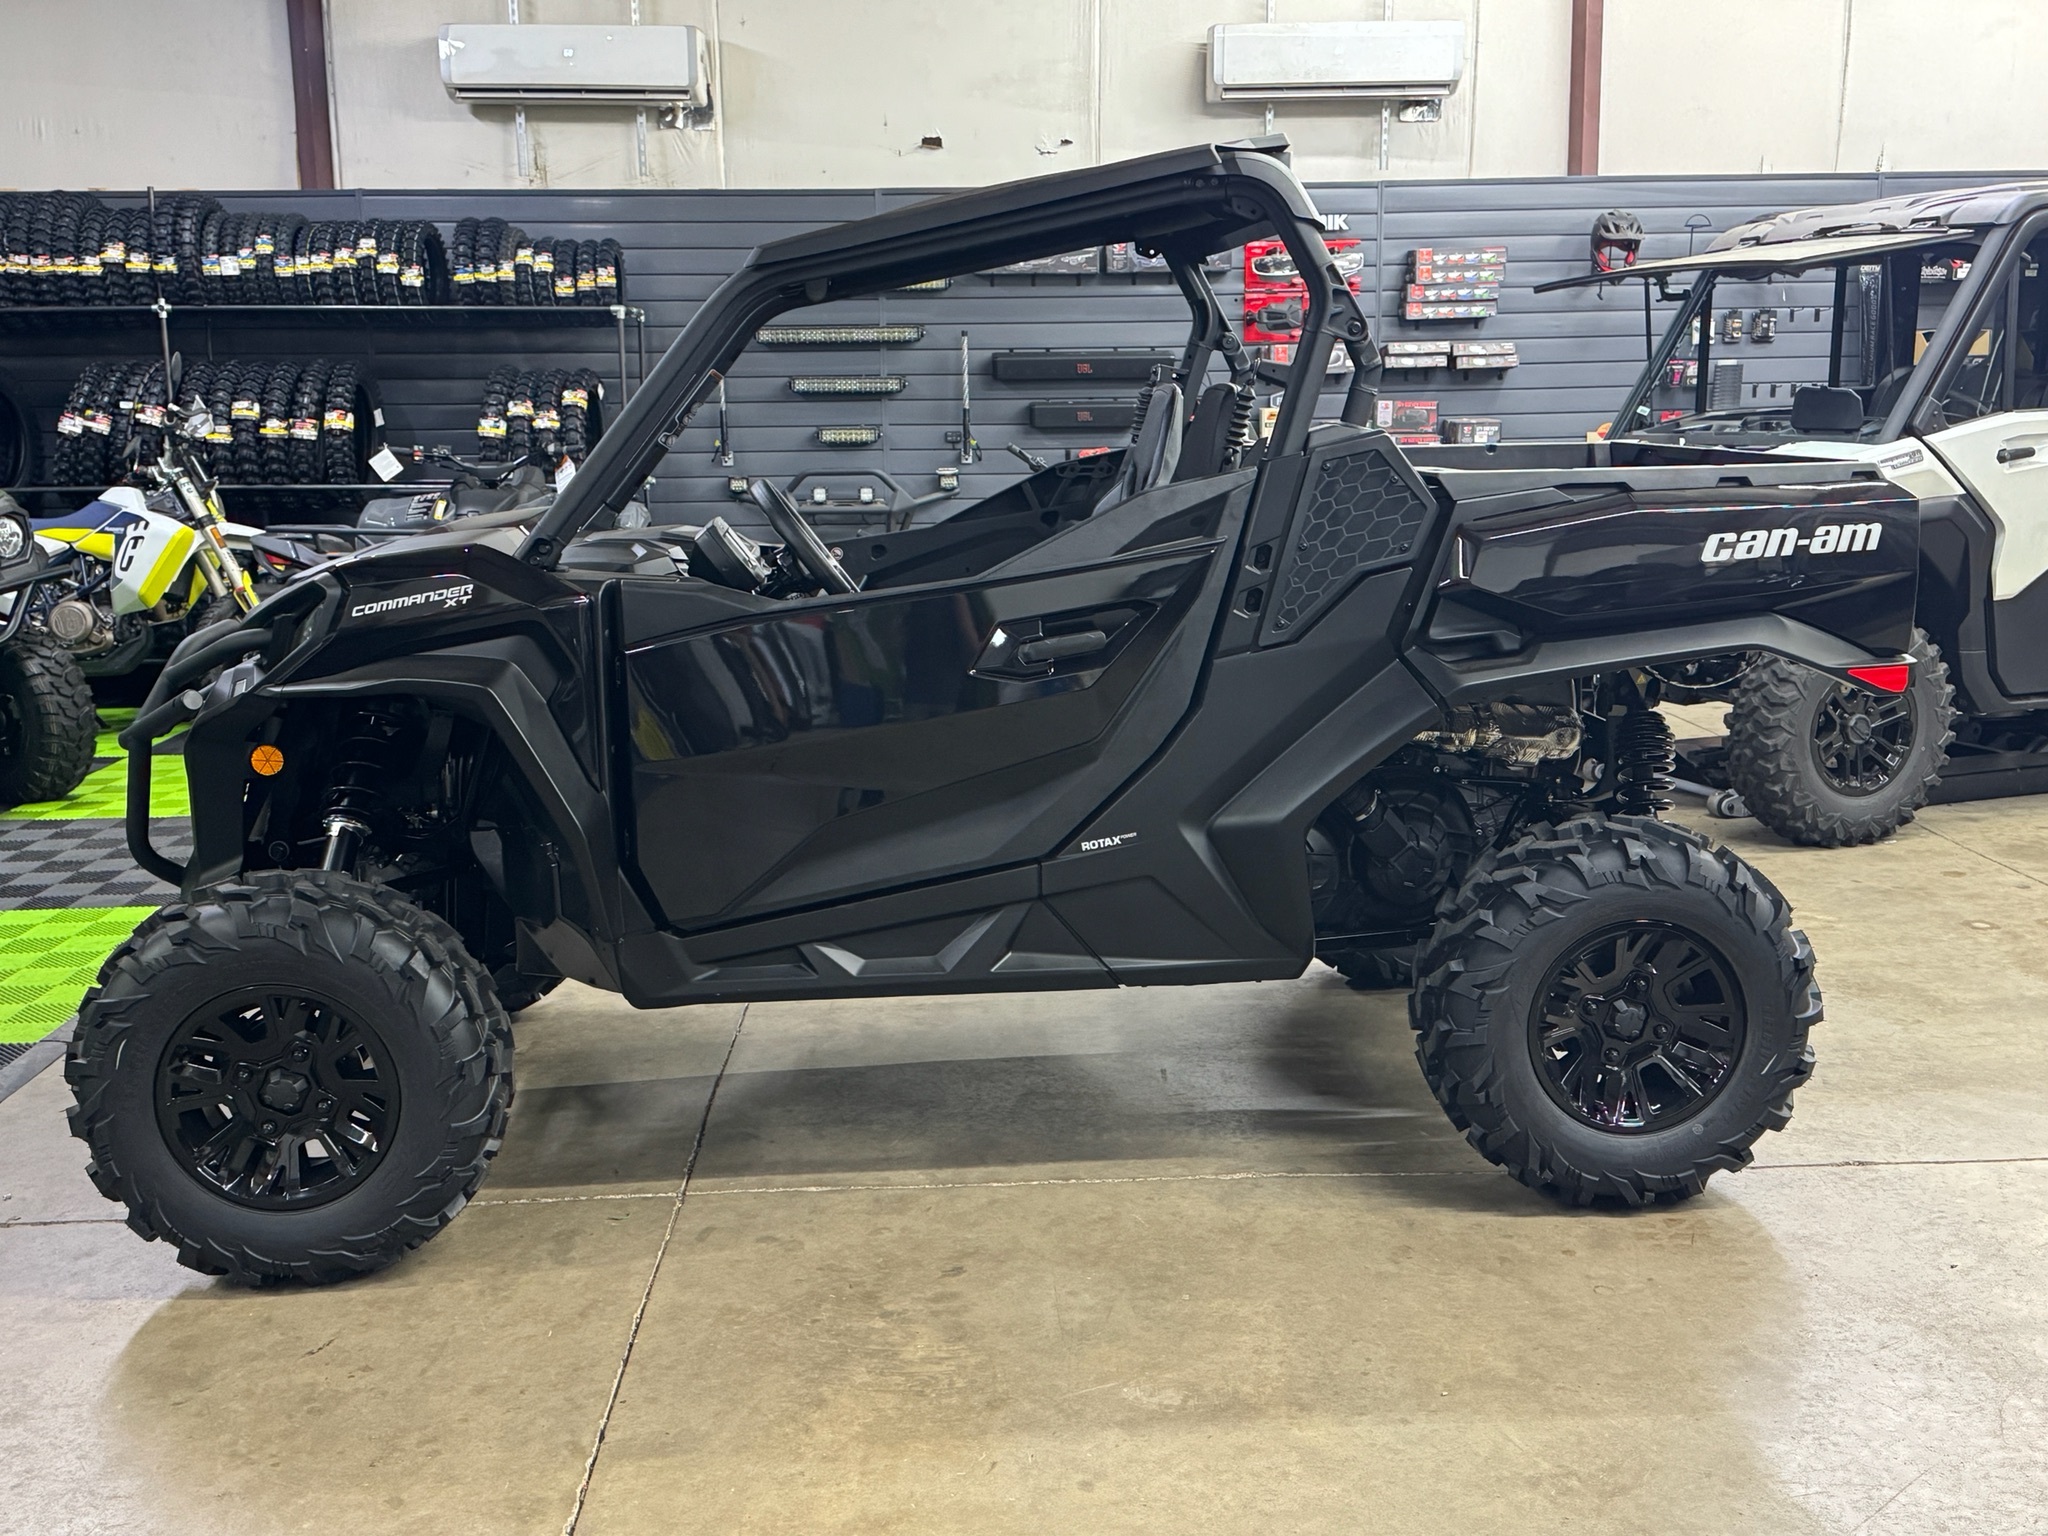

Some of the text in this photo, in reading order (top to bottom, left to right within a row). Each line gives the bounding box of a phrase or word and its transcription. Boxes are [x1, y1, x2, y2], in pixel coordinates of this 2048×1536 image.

[1701, 522, 1882, 562] can-am
[351, 584, 474, 617] COMMANDER
[443, 595, 473, 608] XT
[1081, 835, 1121, 851] ROTAX
